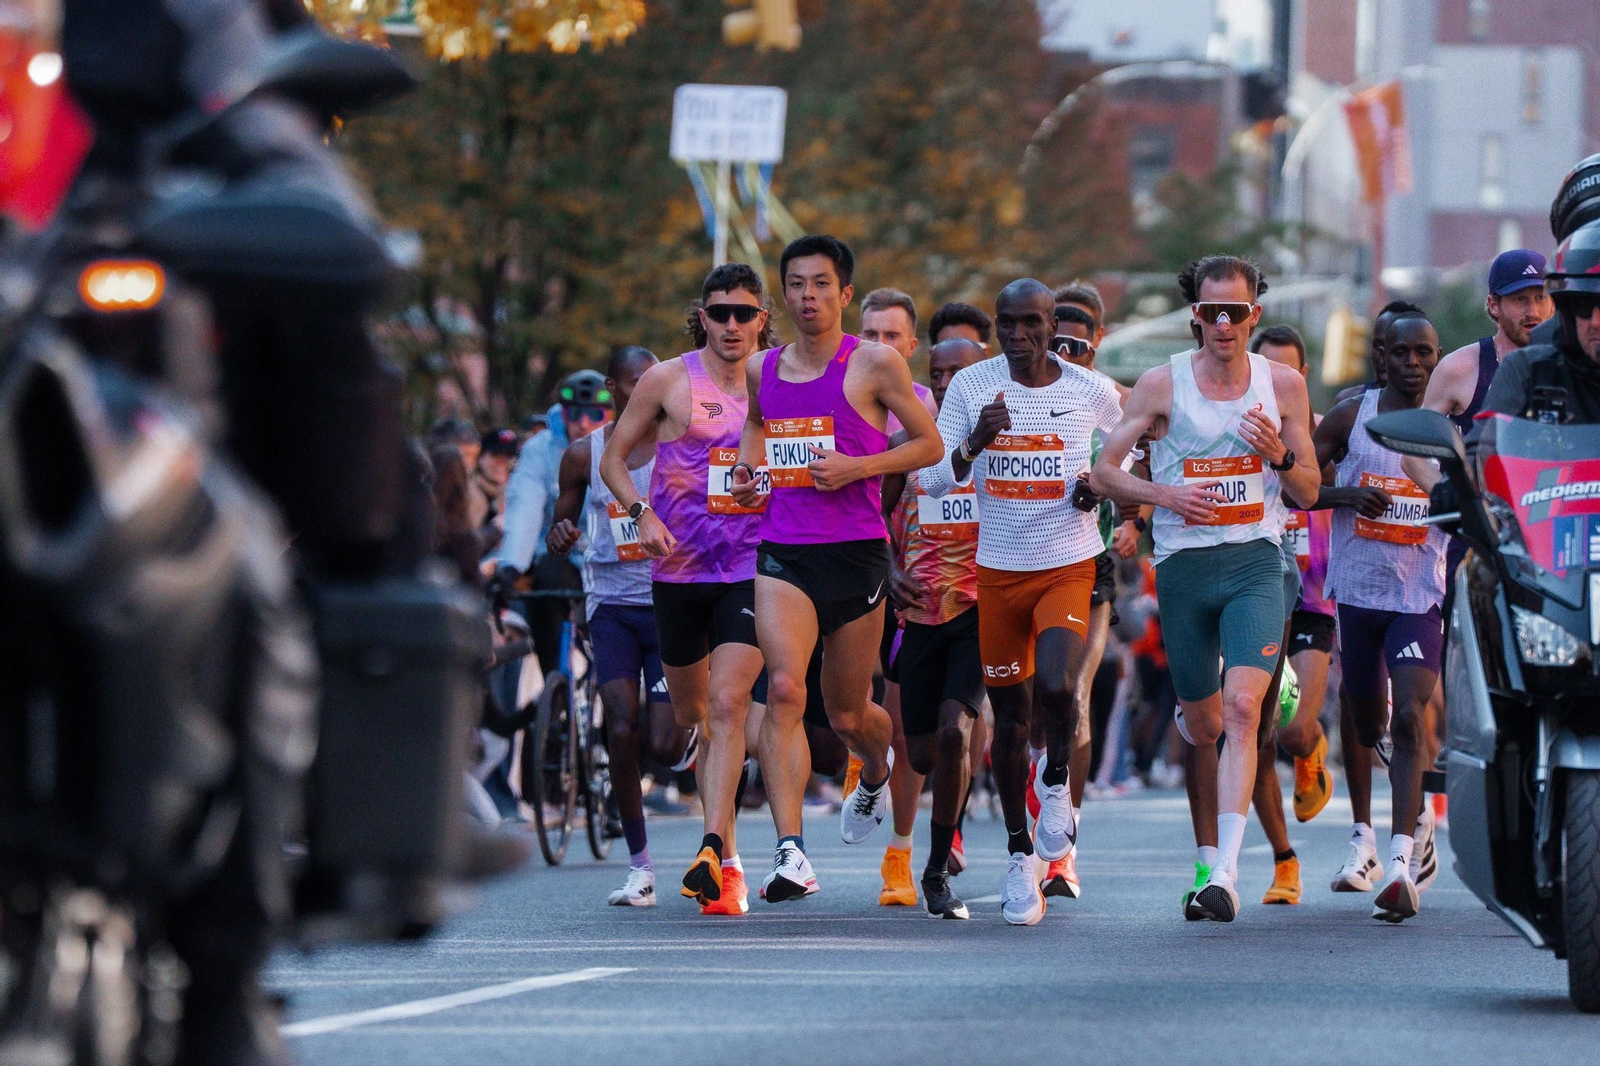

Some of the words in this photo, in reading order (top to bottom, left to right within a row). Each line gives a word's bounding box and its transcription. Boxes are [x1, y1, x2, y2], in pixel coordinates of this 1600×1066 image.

[770, 422, 783, 433] tcs
[994, 437, 1011, 446] tcs
[719, 450, 736, 461] tcs
[988, 455, 1062, 477] KIPCHOGE
[1193, 461, 1210, 472] tcs
[1368, 475, 1384, 488] tcs
[942, 499, 972, 521] BOR
[1239, 508, 1260, 518] 2025
